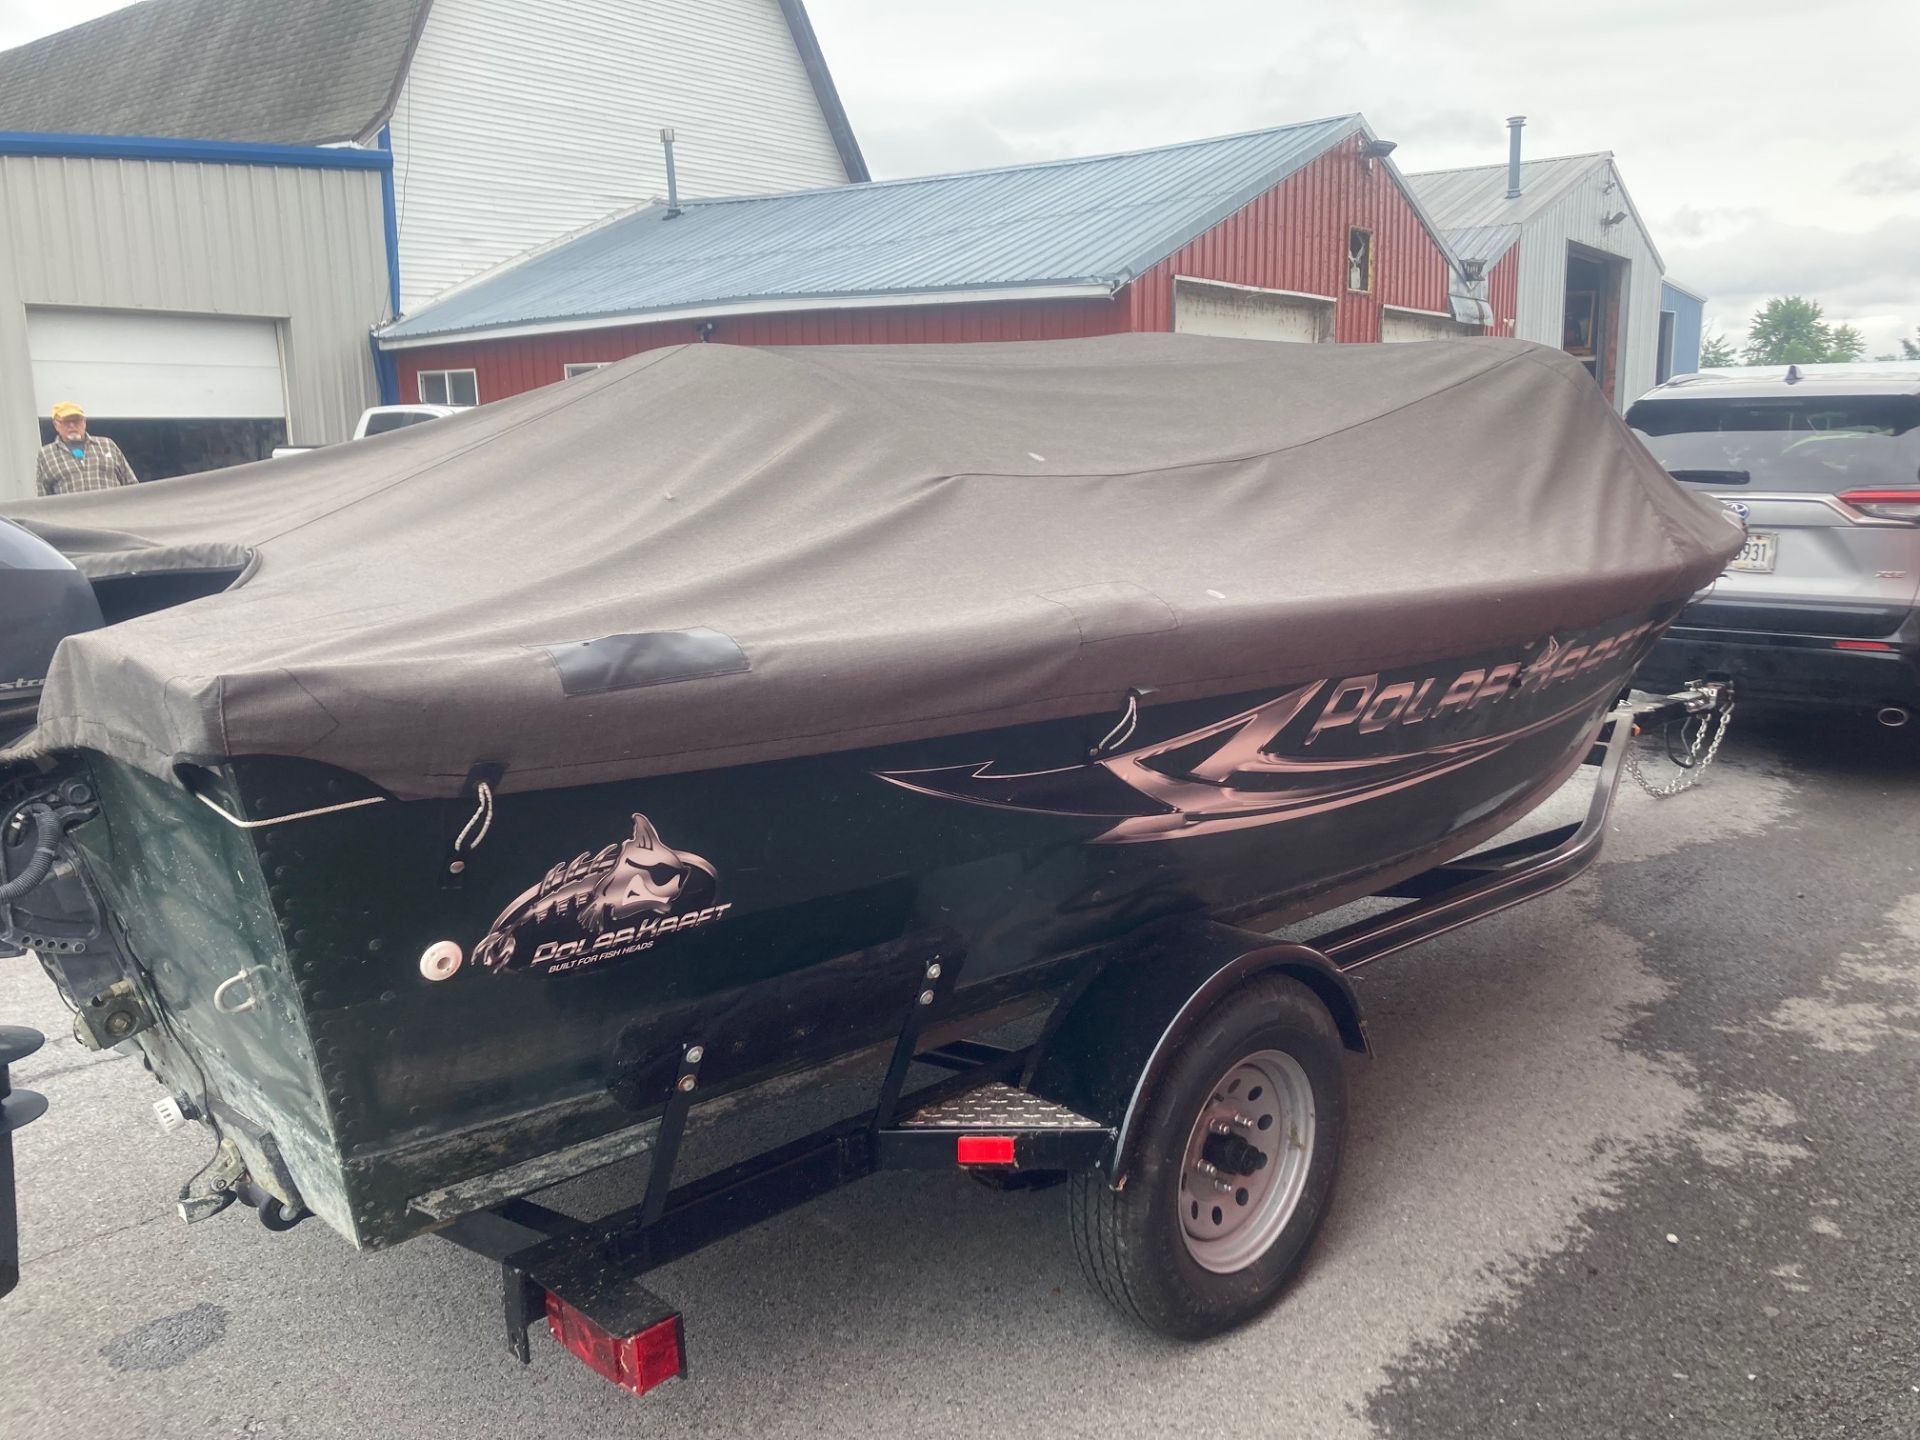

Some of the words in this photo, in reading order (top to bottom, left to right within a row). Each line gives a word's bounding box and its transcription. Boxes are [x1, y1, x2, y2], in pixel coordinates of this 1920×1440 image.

[548, 961, 578, 973] BUILT
[578, 953, 600, 966] FOR
[600, 948, 622, 961] FISH
[622, 941, 655, 955] HEADS
